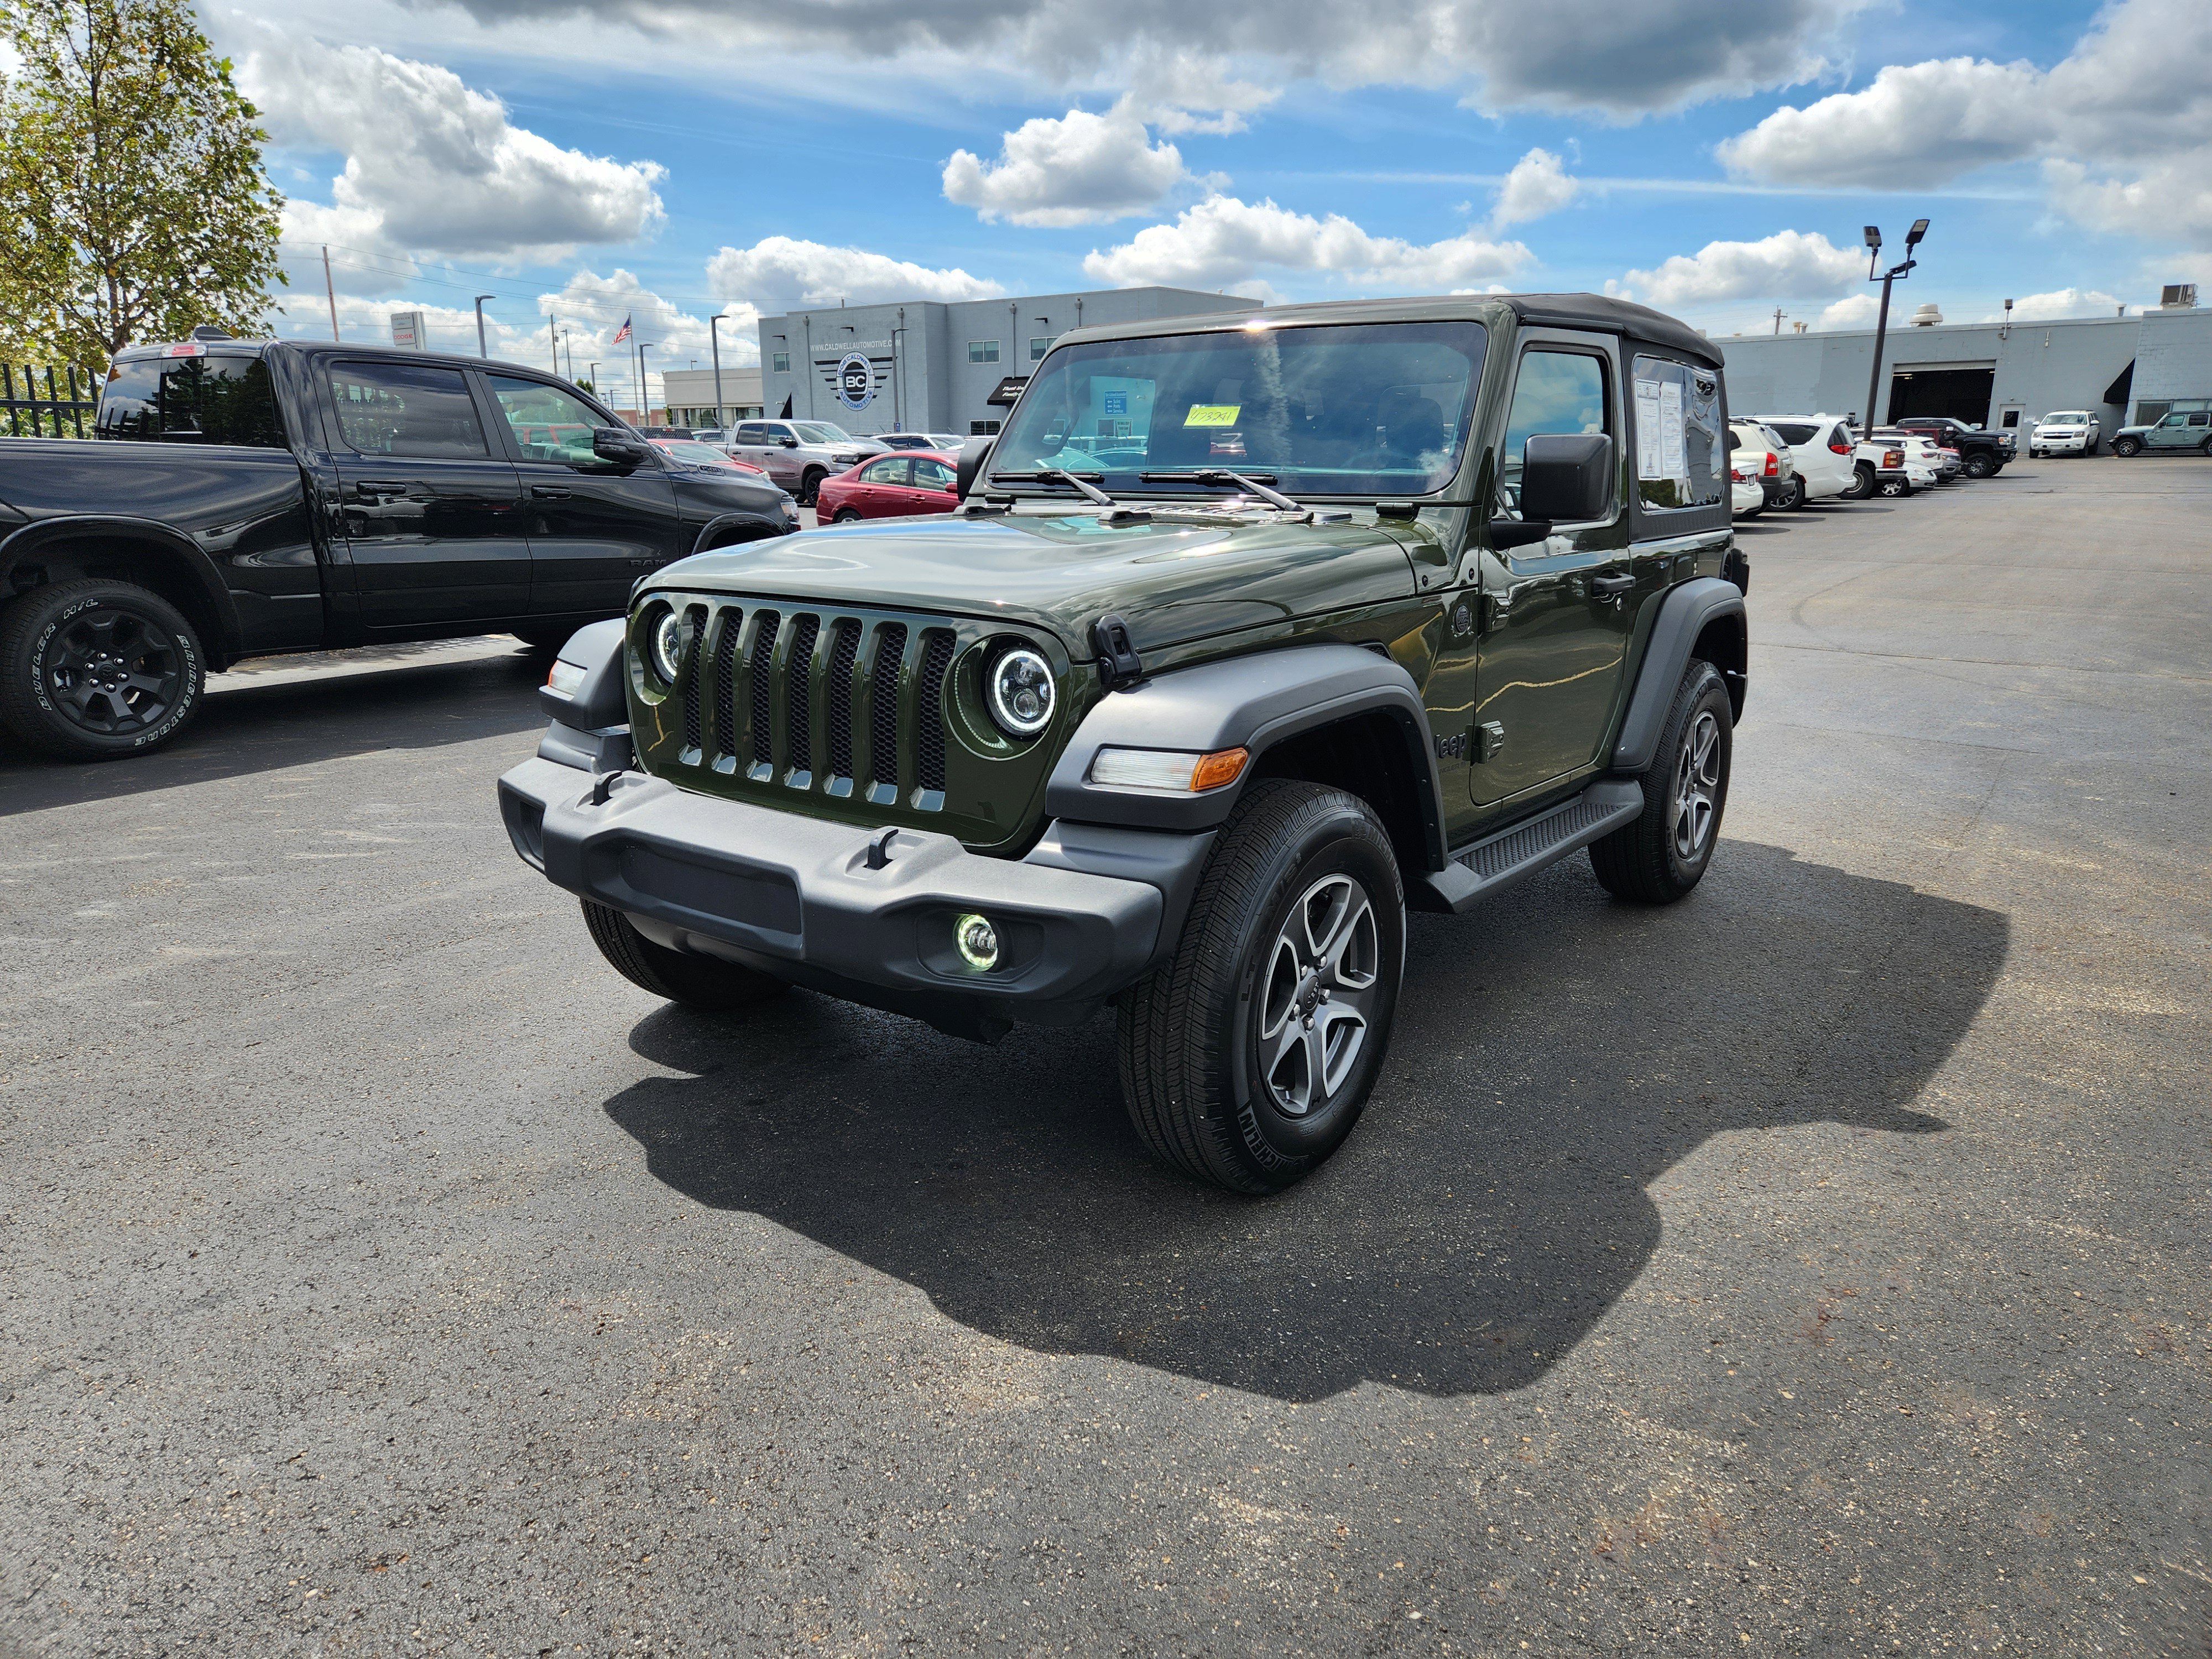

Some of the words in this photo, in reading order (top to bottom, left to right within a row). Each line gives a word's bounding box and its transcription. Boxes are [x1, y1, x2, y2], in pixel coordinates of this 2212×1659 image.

[810, 340, 901, 351] WWW.CALDWELLAUTOMOTIVE.CM
[847, 354, 872, 374] CALDWELL
[846, 375, 866, 388] BC
[839, 389, 873, 409] AUTOMOTIVE
[32, 622, 56, 711] DUELER
[64, 598, 98, 619] H/L
[134, 634, 197, 746] BRIDGESTONE
